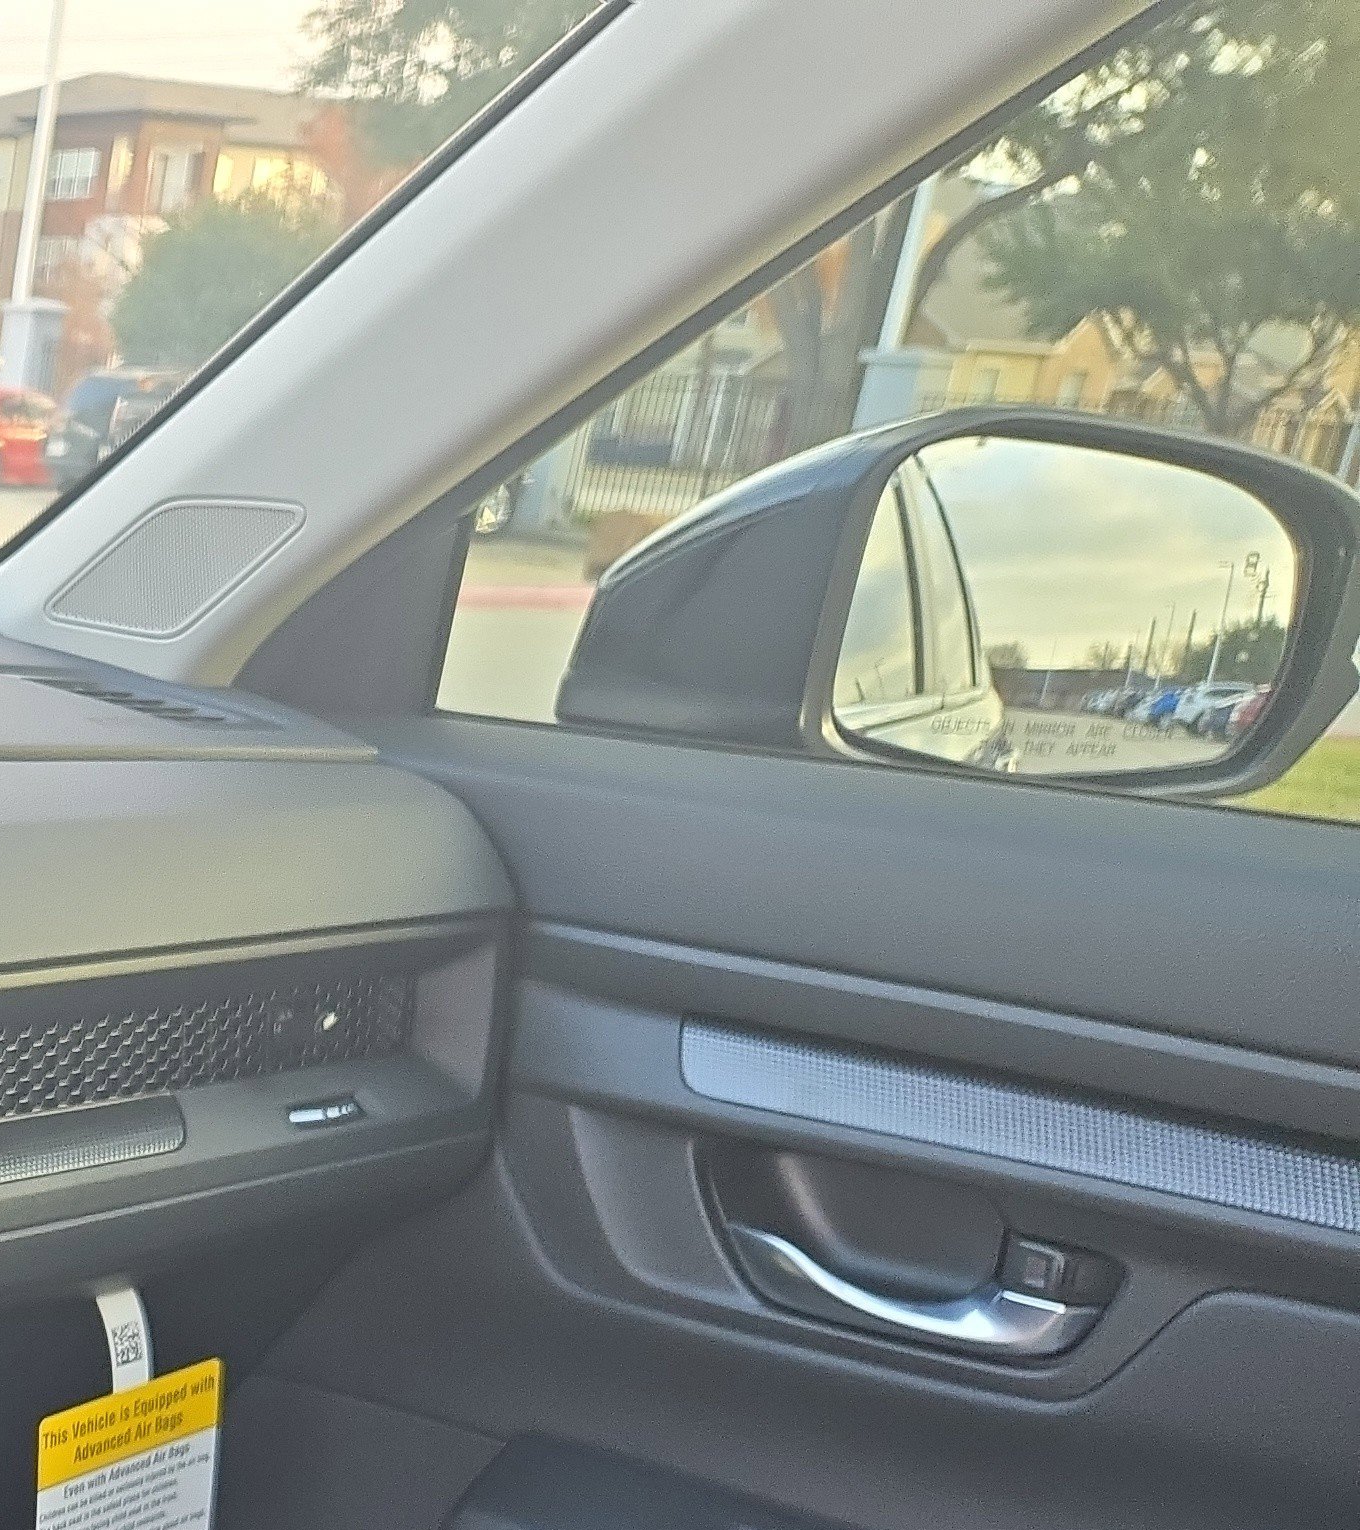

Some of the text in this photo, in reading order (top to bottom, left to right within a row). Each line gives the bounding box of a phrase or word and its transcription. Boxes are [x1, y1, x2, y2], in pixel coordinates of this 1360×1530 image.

[42, 1374, 215, 1451] This Vehicle is Equipped with
[73, 1410, 184, 1462] Advanced Air Bags
